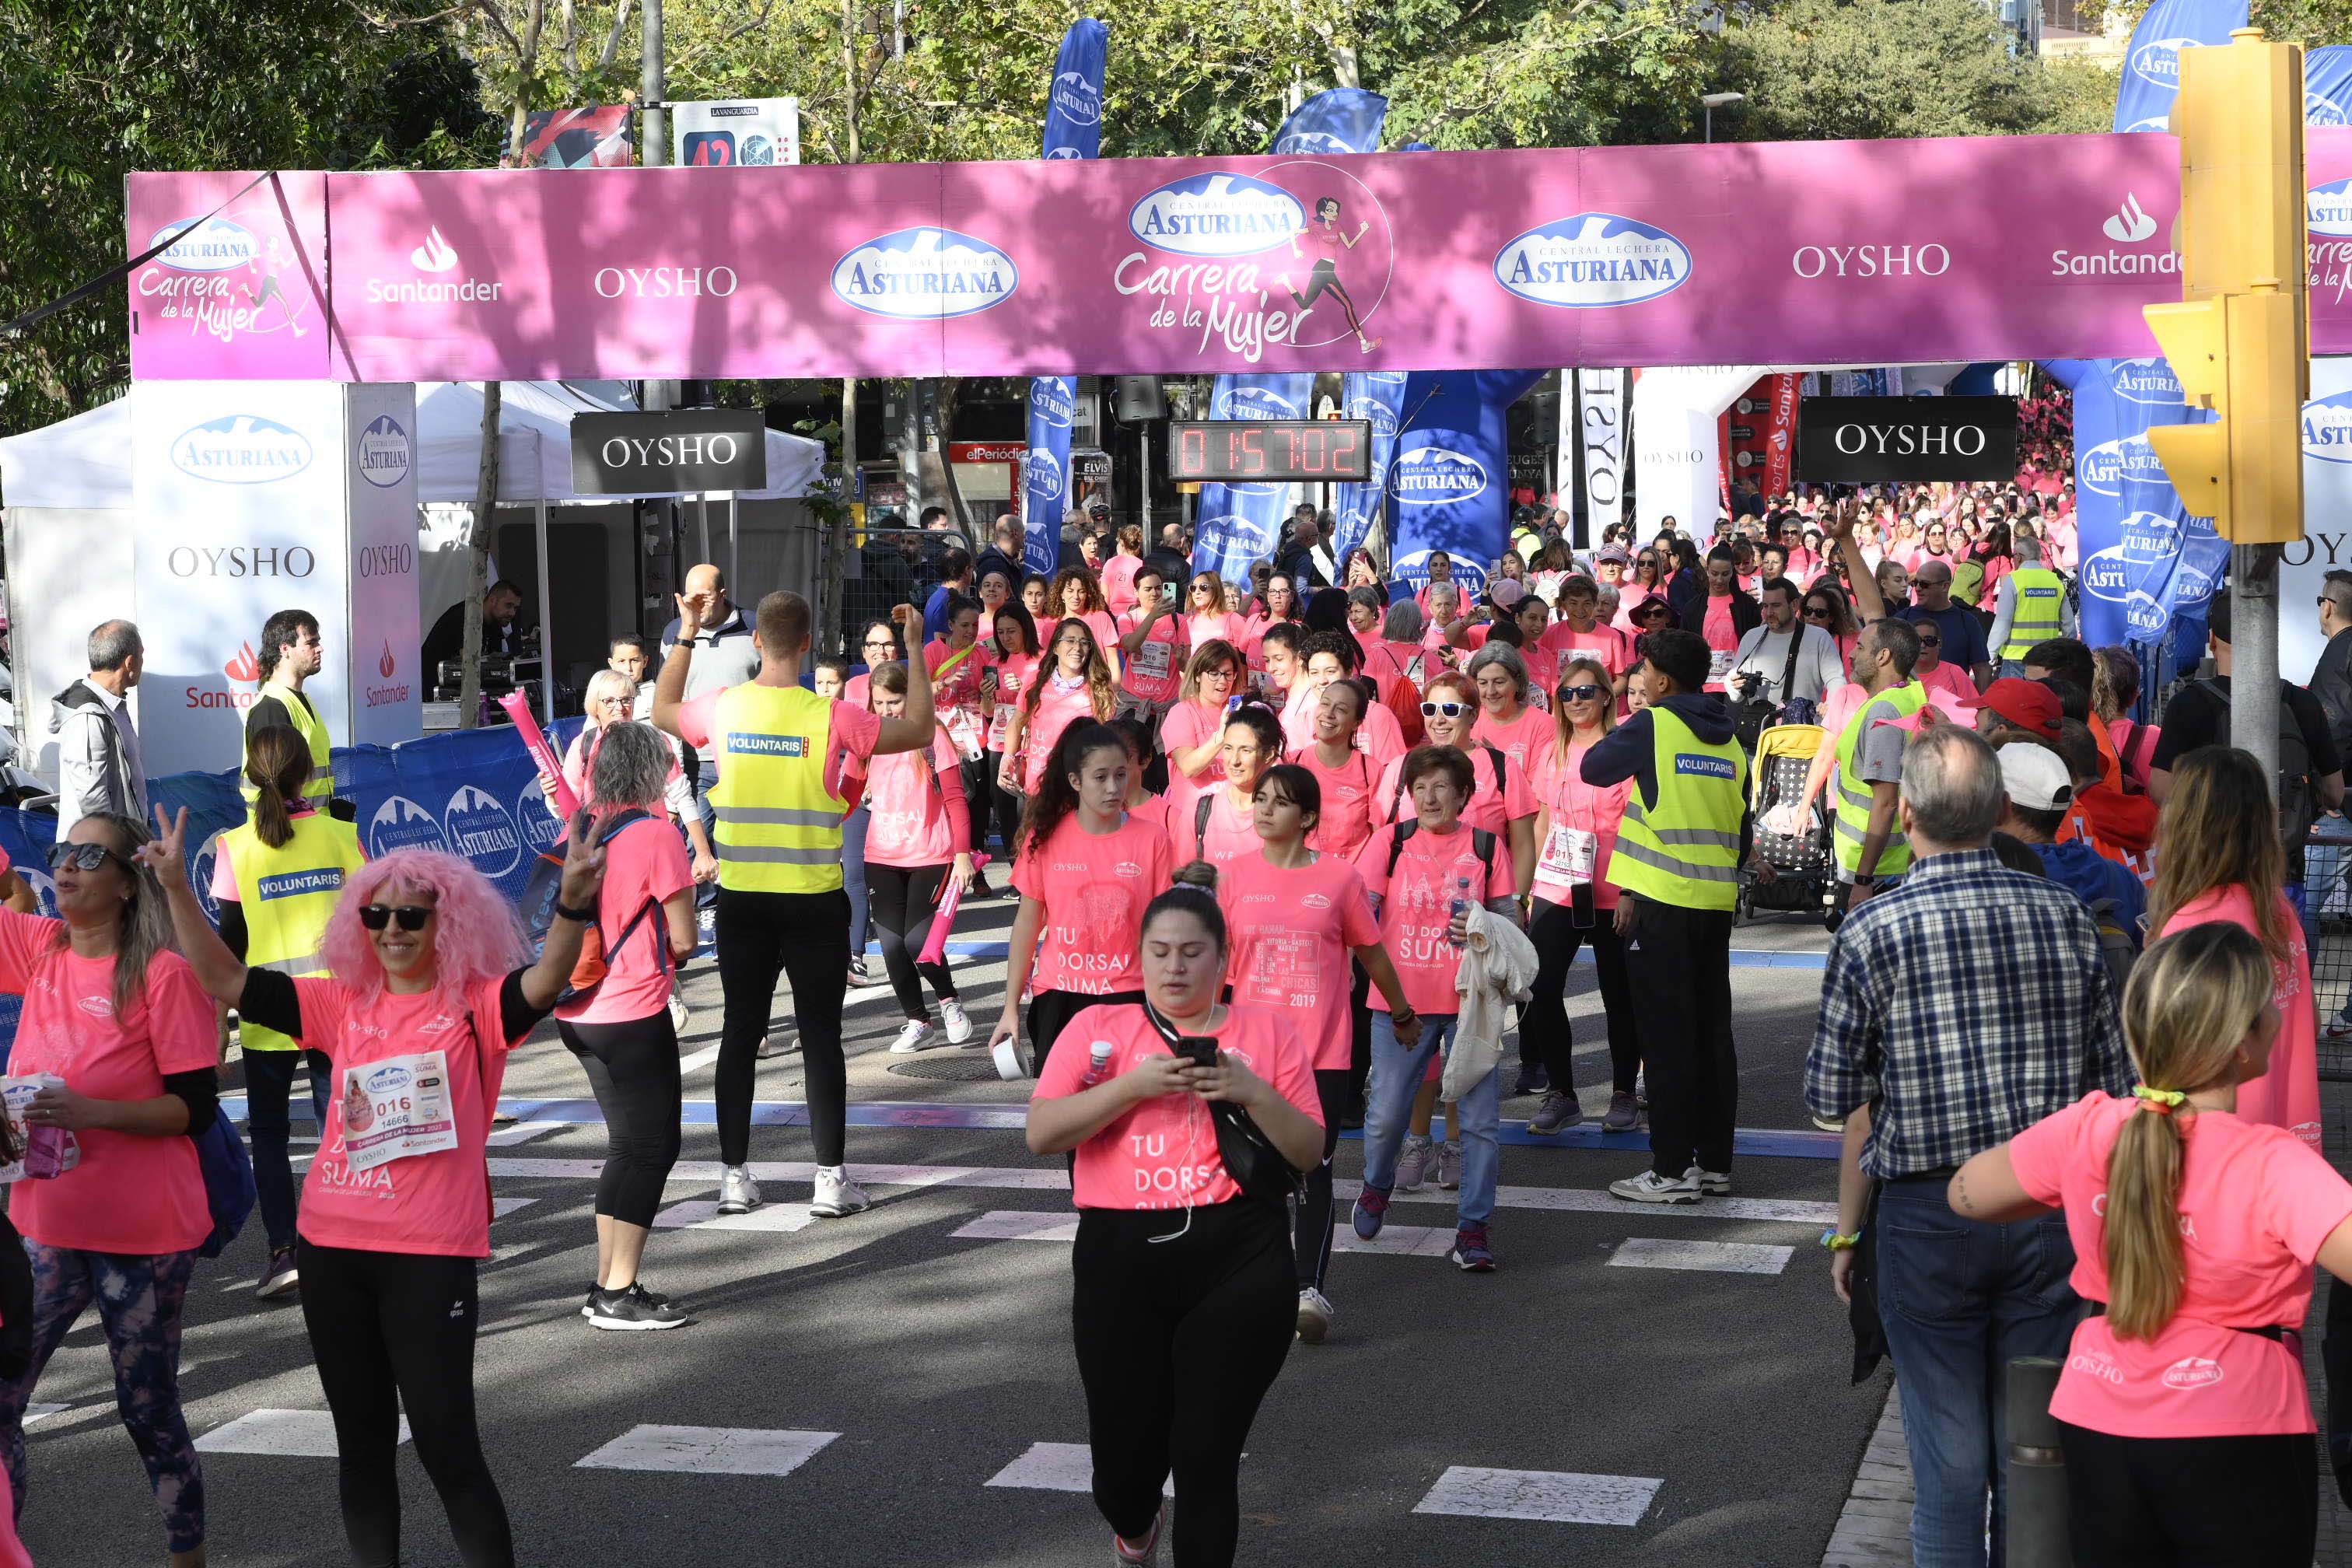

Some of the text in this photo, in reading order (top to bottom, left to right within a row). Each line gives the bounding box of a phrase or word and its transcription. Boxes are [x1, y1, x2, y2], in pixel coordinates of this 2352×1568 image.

[1143, 204, 1293, 236] ASTURIANA
[156, 236, 250, 257] ASTURIANA
[1538, 243, 1671, 257] CENTRAL LECHERA
[1510, 249, 1676, 285] ASTURIANA
[1793, 243, 1951, 278] OYSHO
[138, 268, 229, 297] Carrera
[594, 266, 738, 298] OYSHO
[846, 262, 1004, 296] ASTURIANA
[1114, 252, 1259, 296] Carrera
[367, 279, 502, 303] Santander
[161, 294, 264, 343] de la Mujer
[1150, 291, 1314, 363] de la Mujer
[1835, 423, 1986, 455] OYSHO
[184, 442, 303, 467] ASTURIANA
[362, 443, 407, 470] ASTURIANA
[602, 435, 737, 467] OYSHO
[1084, 463, 1108, 472] ELVIS
[1438, 465, 1476, 474] LECHERA
[1391, 472, 1479, 492] ASTURIANA
[360, 543, 411, 578] OYSHO
[2280, 533, 2352, 566] OY
[168, 546, 315, 578] OYSHO
[366, 684, 411, 708] Santander
[1133, 682, 1161, 691] SUMA
[728, 738, 800, 752] VOLUNTARIS
[1676, 758, 1733, 775] VOLUNTARIS
[452, 824, 518, 857] ASTURIANA
[1053, 863, 1087, 872] OYSHO
[261, 873, 340, 894] VOLUNTARIS
[1243, 894, 1276, 904] OYSHO
[1055, 926, 1076, 945] TU
[1401, 924, 1416, 937] TU
[1057, 974, 1115, 996] SUMA
[1281, 976, 1316, 990] CHICAS
[1290, 993, 1316, 1008] 2019
[415, 1065, 437, 1073] SUMA
[369, 1075, 410, 1090] ASTURIANA
[376, 1096, 412, 1117] 016
[381, 1115, 409, 1129] 14666
[385, 1132, 393, 1140] DE
[394, 1129, 402, 1139] LA
[1131, 1134, 1164, 1157] TU
[356, 1136, 448, 1164] OYSHO Santander
[321, 1161, 394, 1191] SUMA
